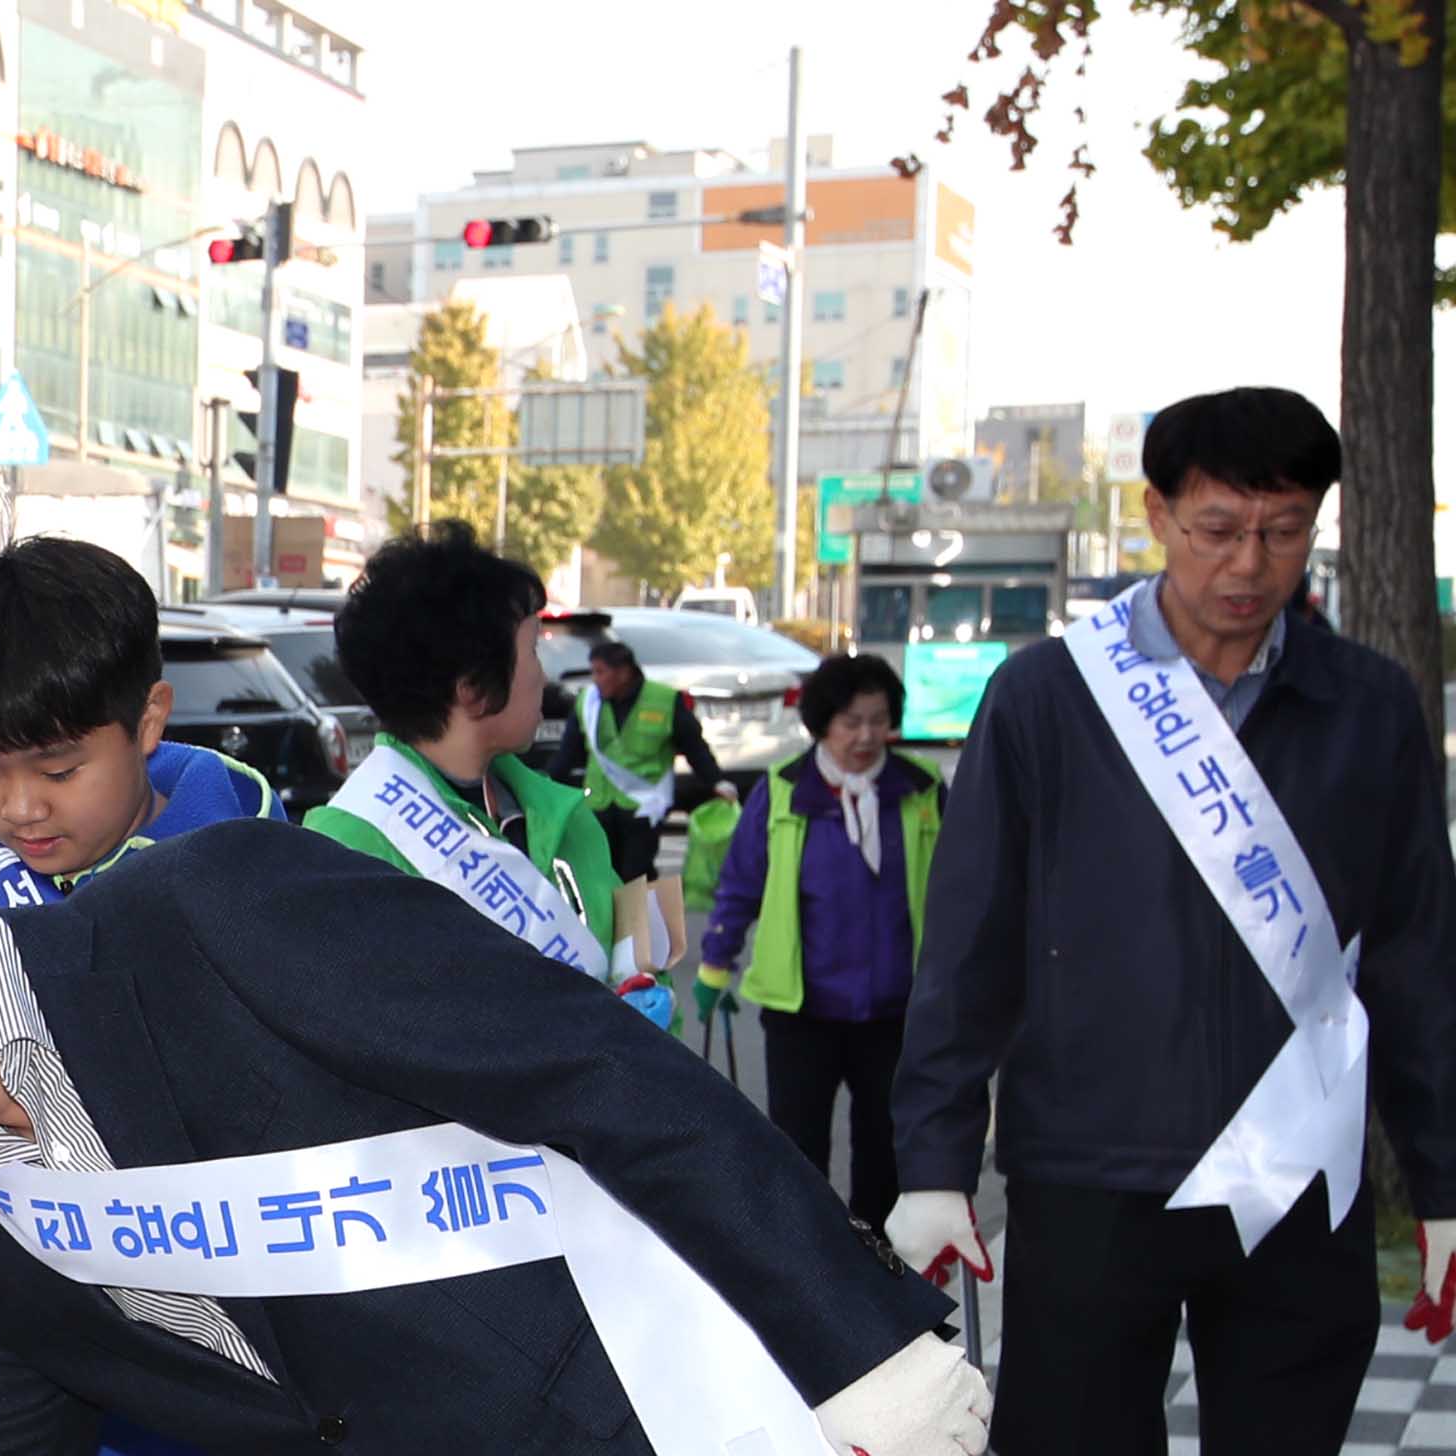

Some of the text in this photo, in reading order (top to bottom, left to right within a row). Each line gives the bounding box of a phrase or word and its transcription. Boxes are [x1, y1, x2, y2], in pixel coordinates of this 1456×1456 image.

[1127, 672, 1201, 757] 앞은
[1177, 755, 1256, 836] 내가
[373, 772, 472, 858] 버리면
[29, 1199, 93, 1252] 집
[104, 1200, 239, 1260] 앞은
[257, 1174, 394, 1256] 내가
[419, 1154, 549, 1235] 쓸기
